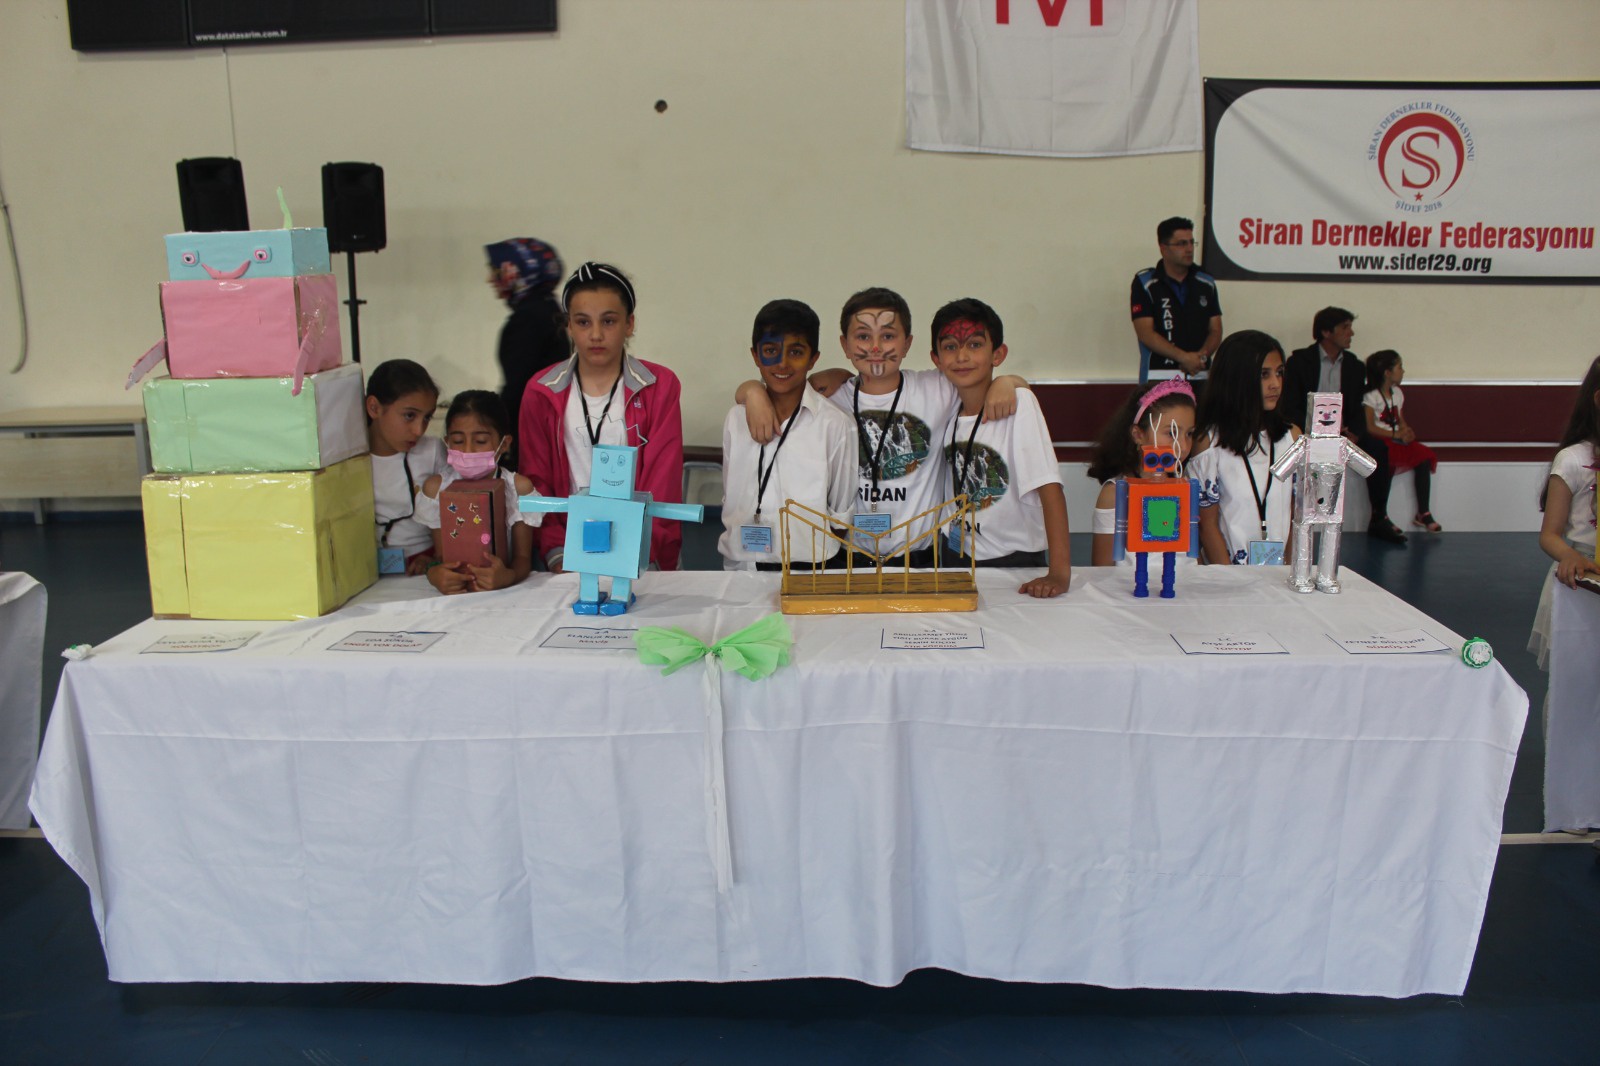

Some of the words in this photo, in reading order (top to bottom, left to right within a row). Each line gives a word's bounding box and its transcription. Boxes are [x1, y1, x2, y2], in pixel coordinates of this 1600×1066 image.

[1368, 129, 1382, 160] ŞİRAN
[1380, 102, 1432, 130] DERNEKLER
[1434, 103, 1475, 162] FEDERASYONU
[1424, 202, 1442, 212] 2018
[1238, 218, 1302, 248] Şiran
[1311, 219, 1432, 248] Dernekler
[1440, 222, 1595, 252] Federasyonu
[1339, 254, 1492, 274] www.sidef29.org
[1161, 298, 1174, 345] ZABI
